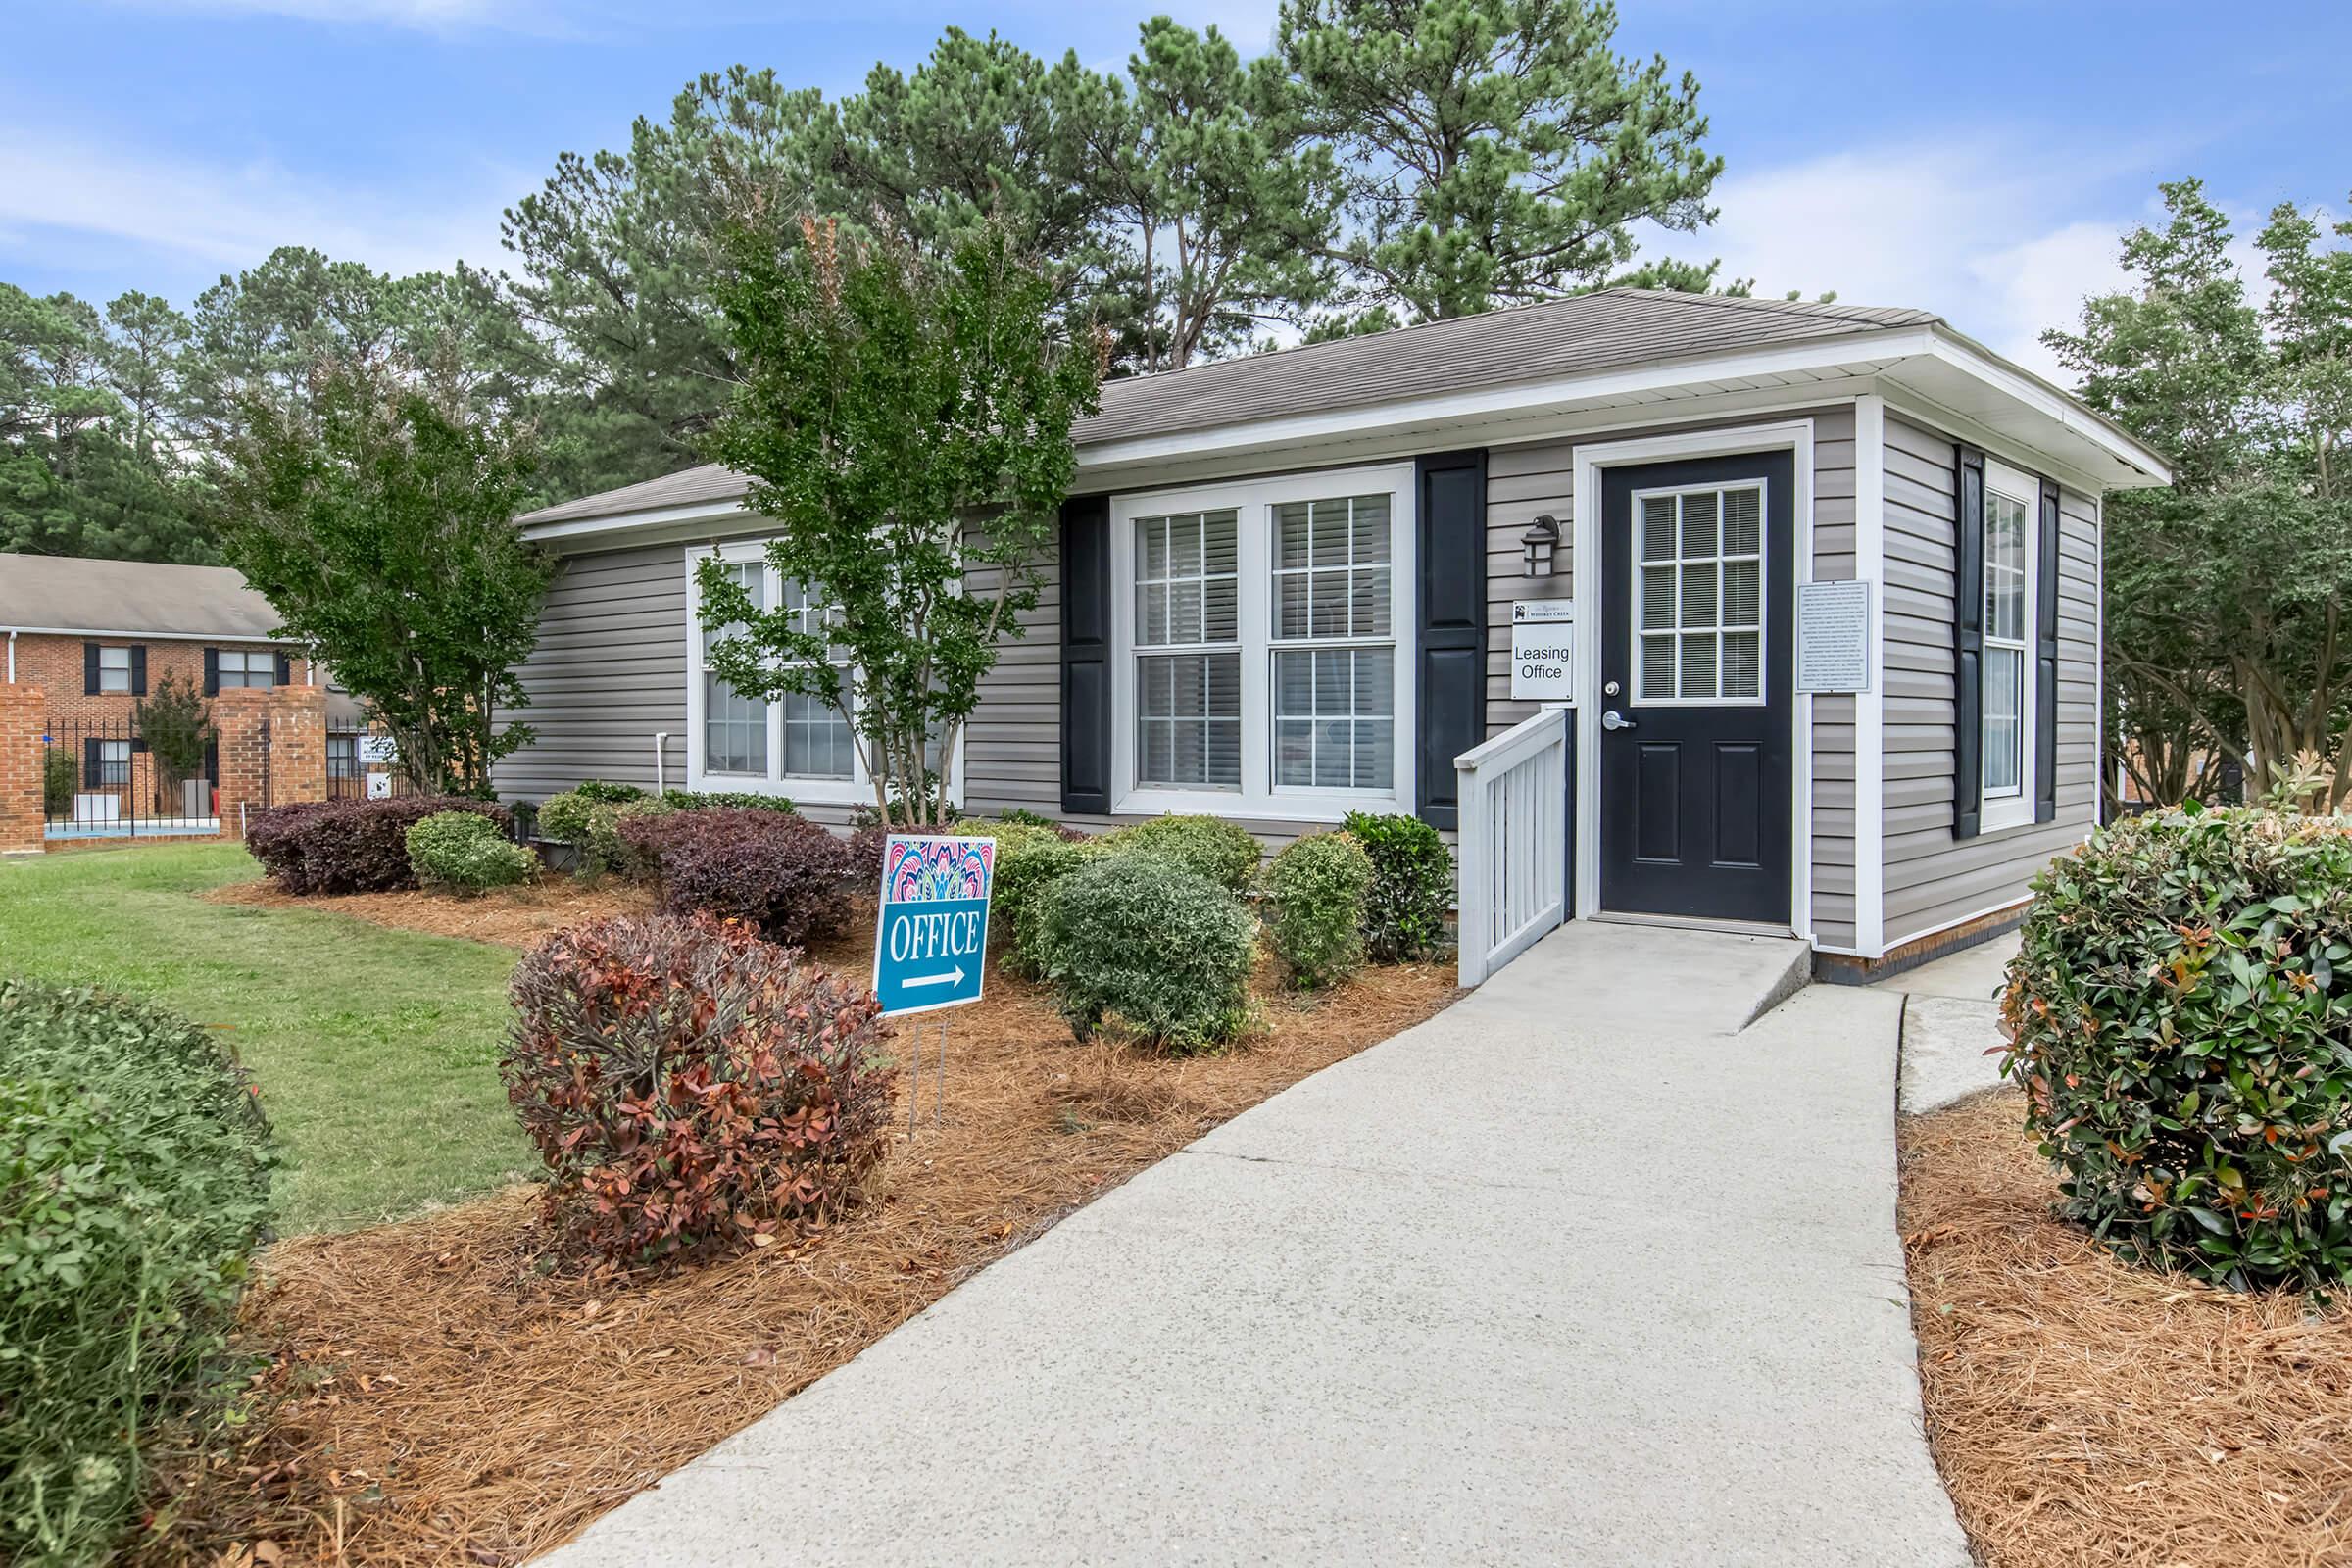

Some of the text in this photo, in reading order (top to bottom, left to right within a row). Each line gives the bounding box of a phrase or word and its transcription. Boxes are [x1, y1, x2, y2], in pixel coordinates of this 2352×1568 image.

[1515, 646, 1569, 662] Leasing
[1522, 664, 1562, 679] Office
[890, 911, 980, 962] OFFICE
